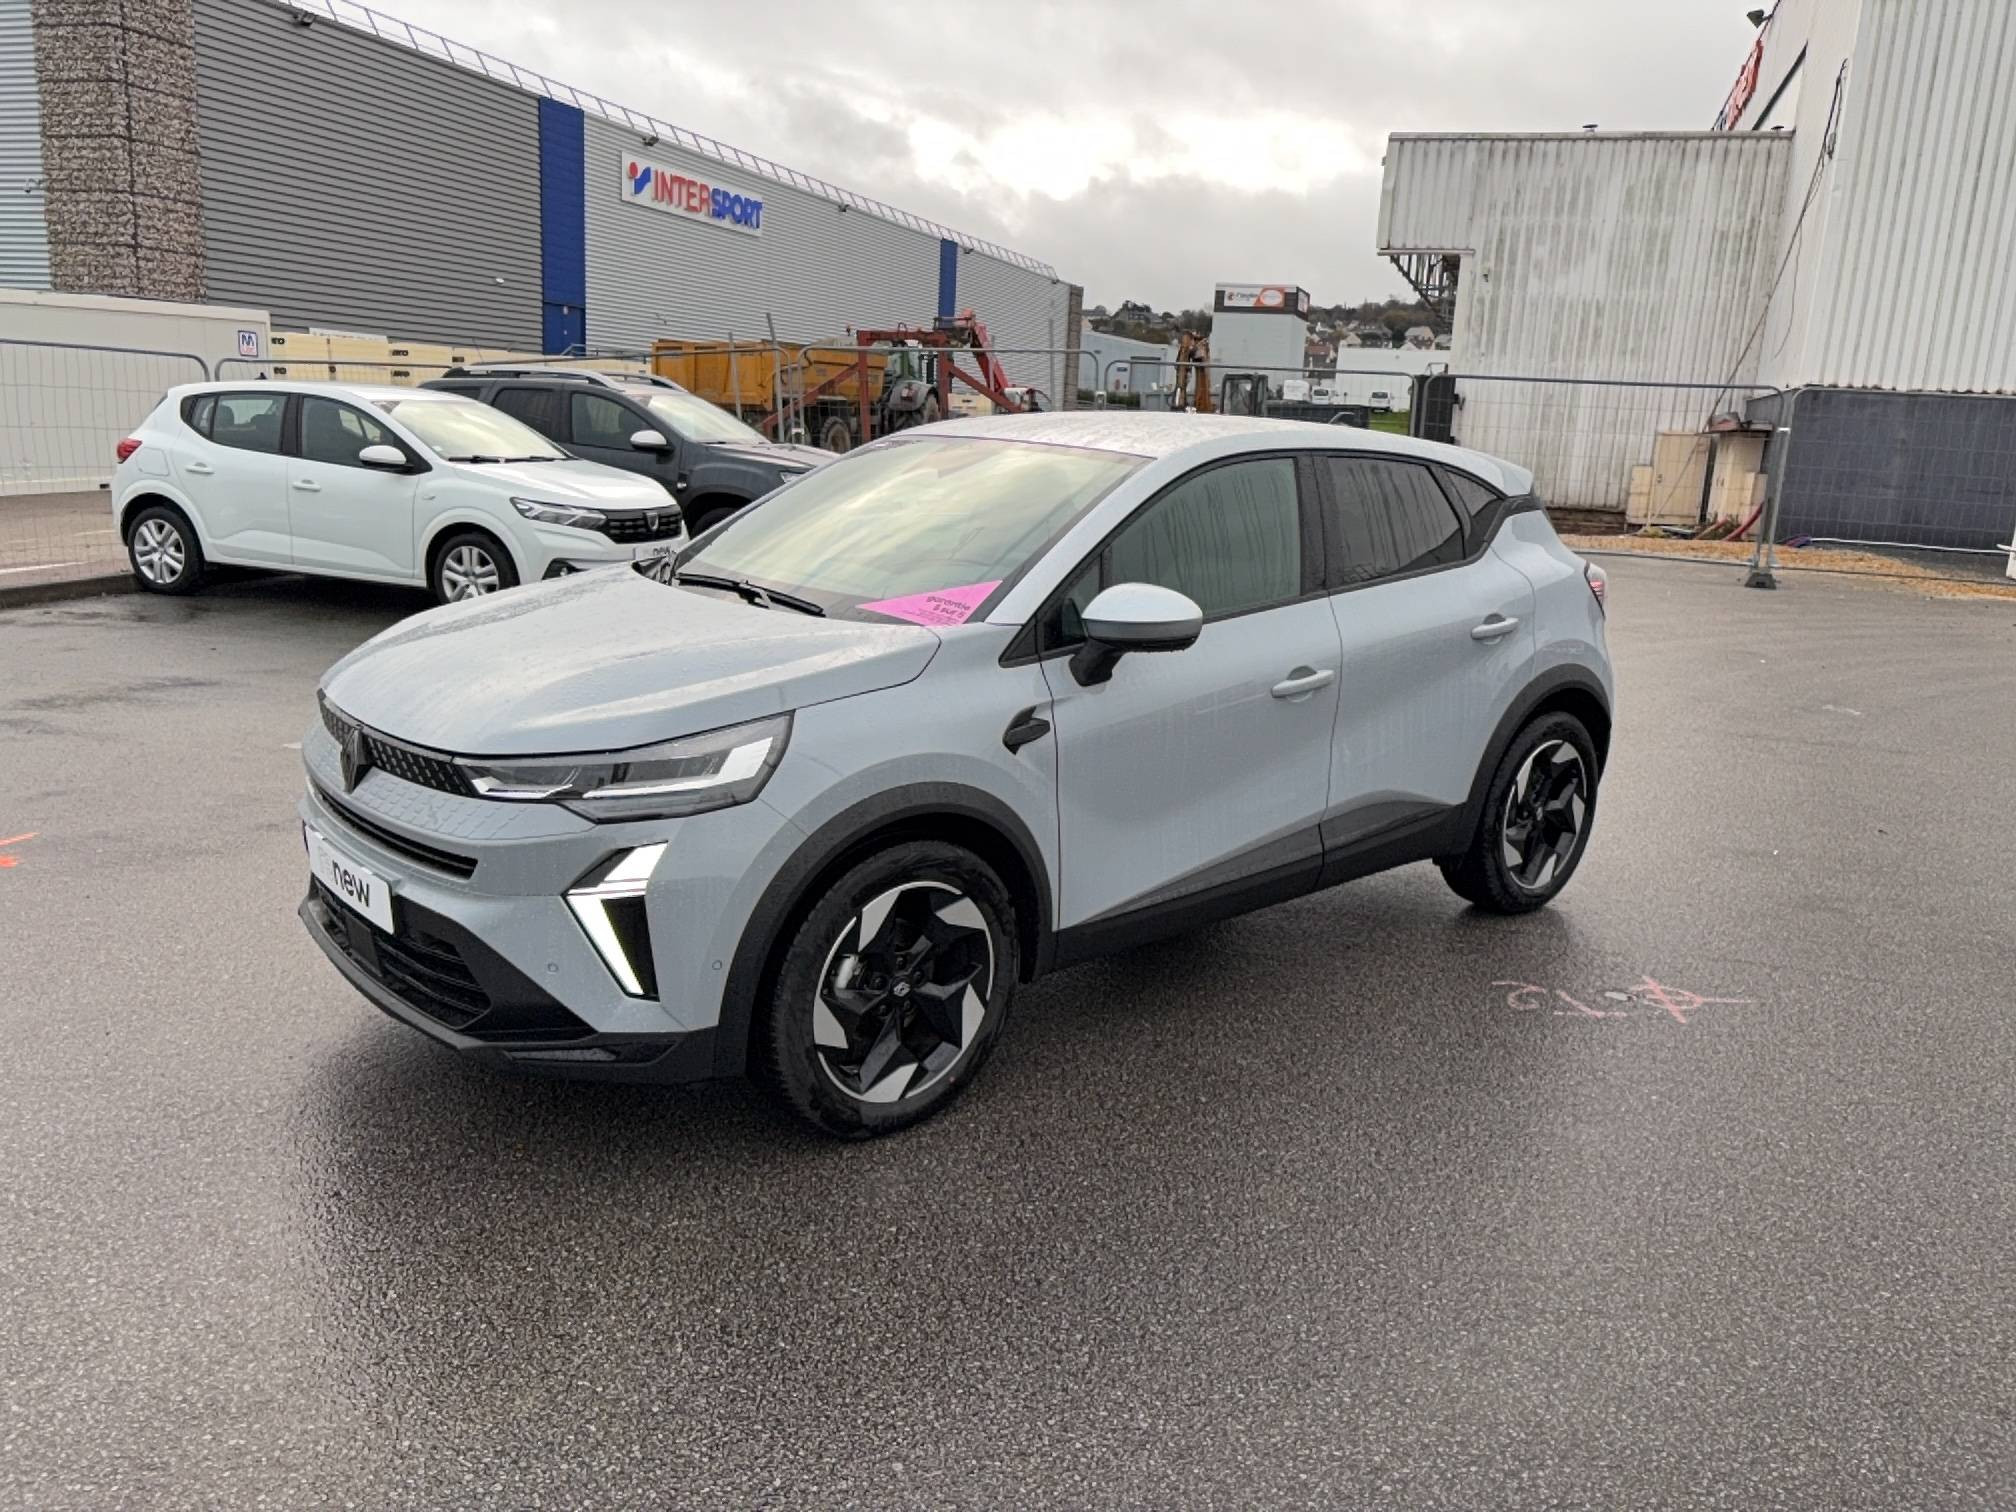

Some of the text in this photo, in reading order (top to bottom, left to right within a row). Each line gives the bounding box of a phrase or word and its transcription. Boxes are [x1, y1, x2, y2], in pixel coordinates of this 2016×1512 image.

[653, 169, 763, 229] INTERSPORT
[926, 596, 971, 611] garantie
[332, 860, 370, 908] new
